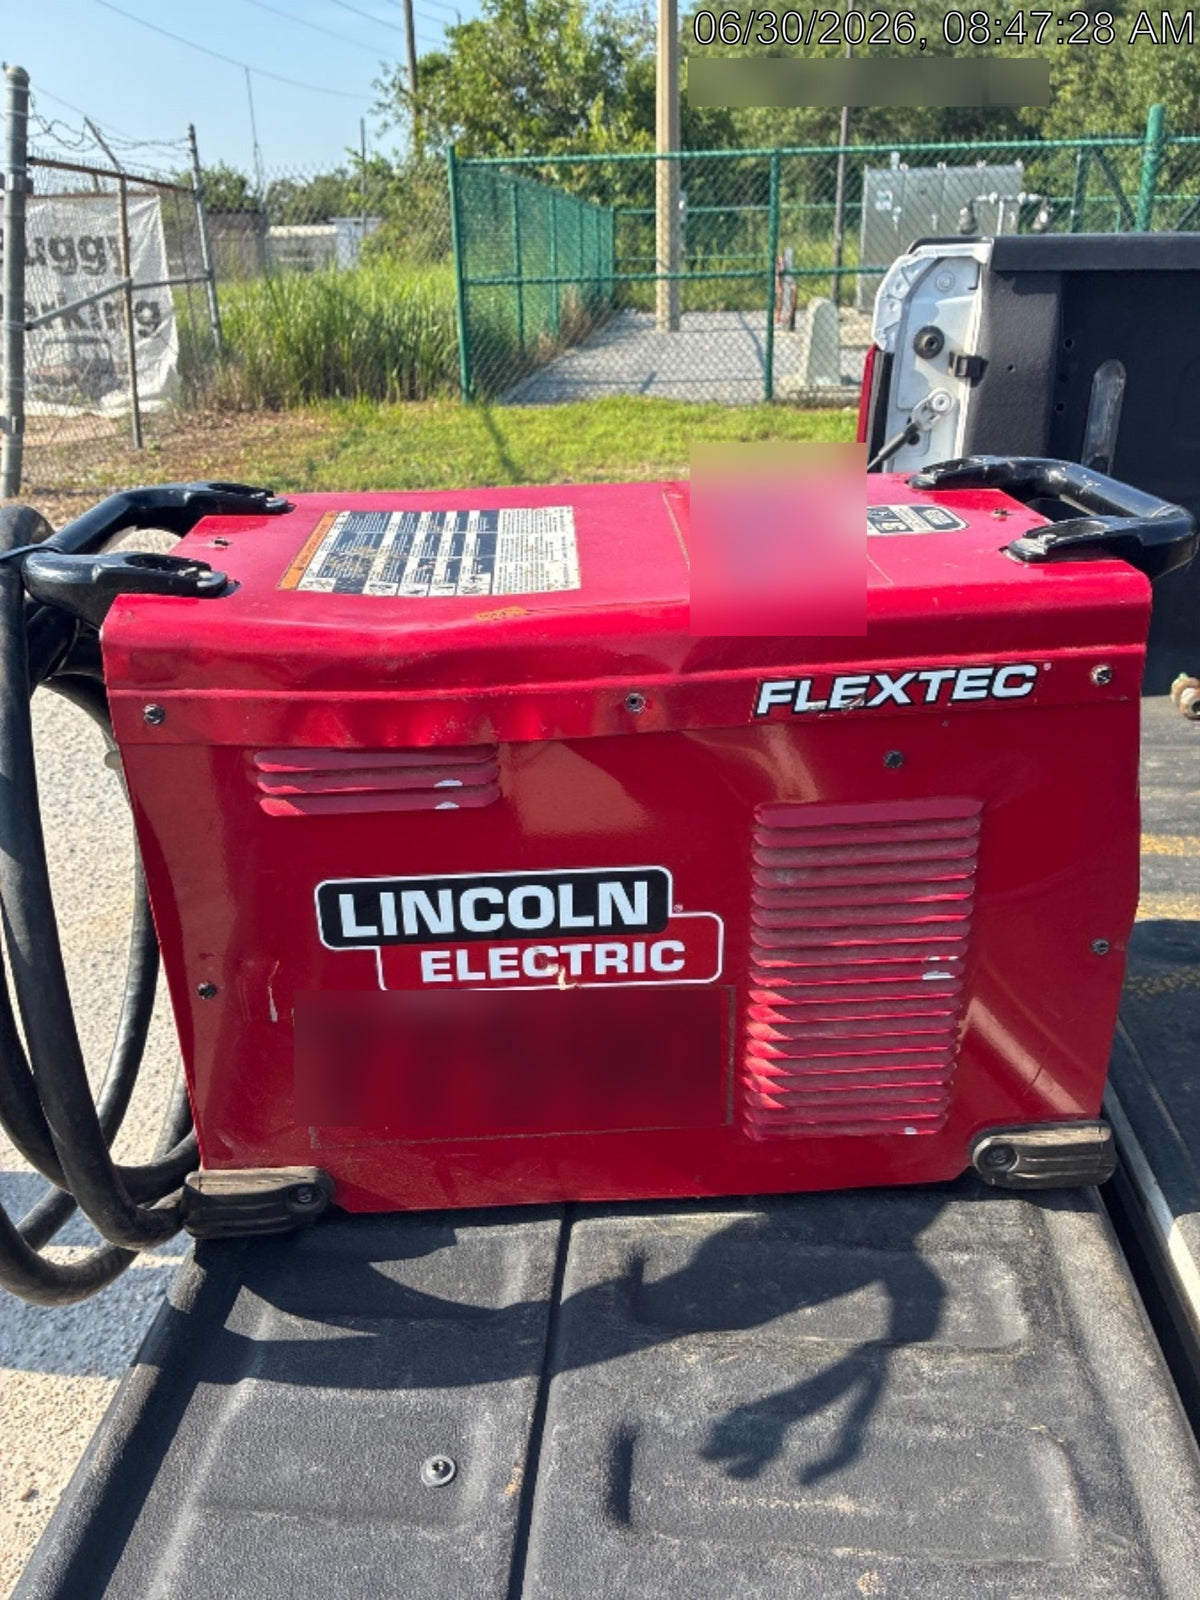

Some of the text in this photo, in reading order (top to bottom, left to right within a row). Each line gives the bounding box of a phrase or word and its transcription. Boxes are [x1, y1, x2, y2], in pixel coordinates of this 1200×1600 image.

[755, 664, 1039, 714] FLEXTEC
[338, 880, 649, 938] LINCOLN
[420, 939, 686, 983] ELECTRIC
